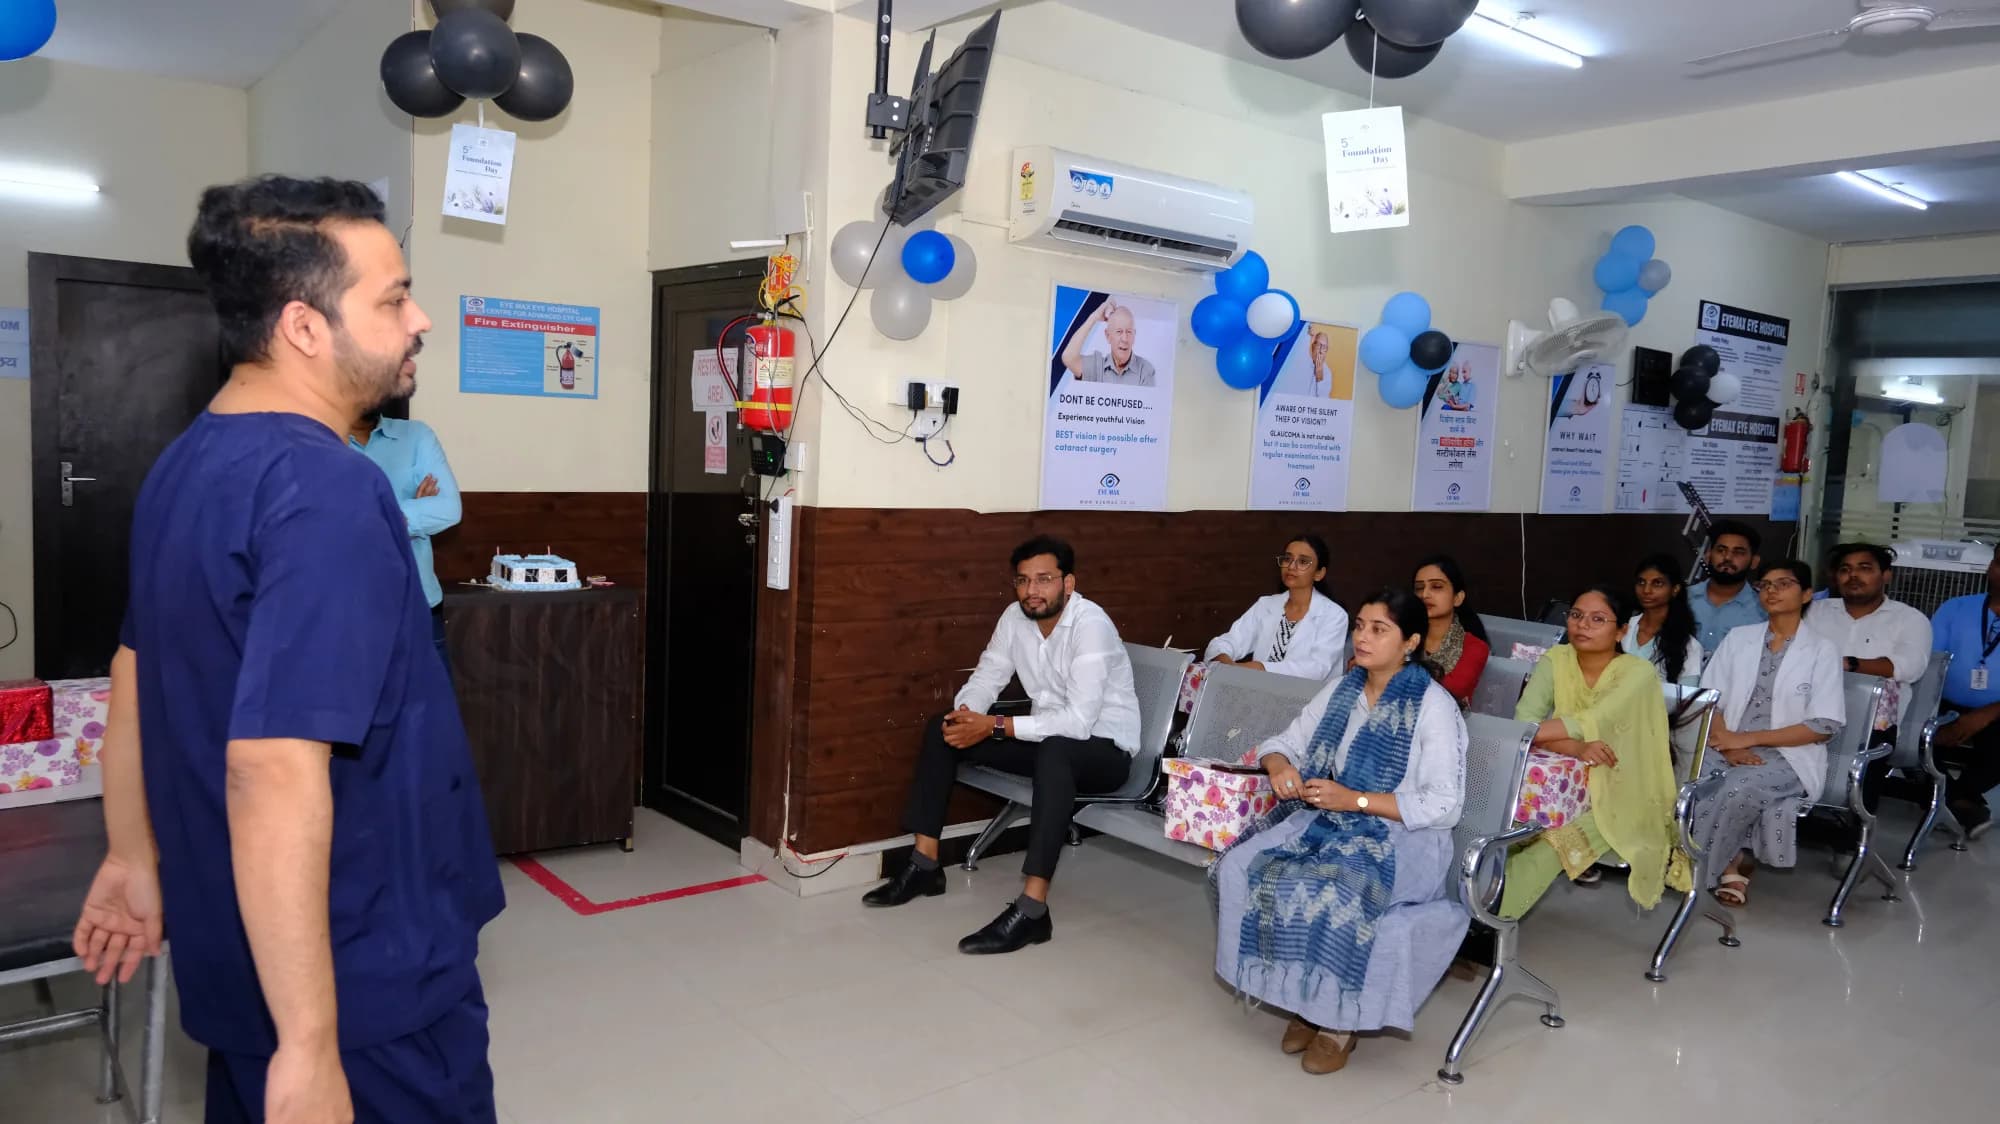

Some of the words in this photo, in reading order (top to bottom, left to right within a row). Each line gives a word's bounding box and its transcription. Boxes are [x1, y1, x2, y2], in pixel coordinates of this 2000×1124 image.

[1342, 145, 1392, 157] Foundation
[462, 155, 502, 166] Foundation
[1373, 156, 1388, 164] Day
[486, 166, 498, 174] Day
[546, 306, 580, 315] HOSPITAL
[474, 318, 498, 326] Fire
[501, 320, 576, 333] Extinguisher
[1759, 320, 1787, 339] HOSPITAL
[708, 384, 724, 400] AREA
[1060, 394, 1083, 404] DONT
[1086, 396, 1095, 406] BE
[1276, 404, 1296, 412] AWARE
[1058, 412, 1094, 422] Experience
[1737, 420, 1748, 434] EYE
[1750, 422, 1776, 436] HOSPITAL
[1056, 430, 1073, 438] BEST
[1076, 432, 1096, 440] vision
[1100, 432, 1105, 440] is
[1108, 434, 1137, 443] possible
[1140, 434, 1157, 444] after
[1270, 430, 1300, 438] GLAUCOMA
[1560, 432, 1575, 440] WHY
[1579, 432, 1596, 442] WAIT
[1055, 444, 1088, 452] cataract
[1089, 447, 1117, 456] surgery
[1300, 442, 1328, 450] controlled
[1263, 450, 1283, 459] regular
